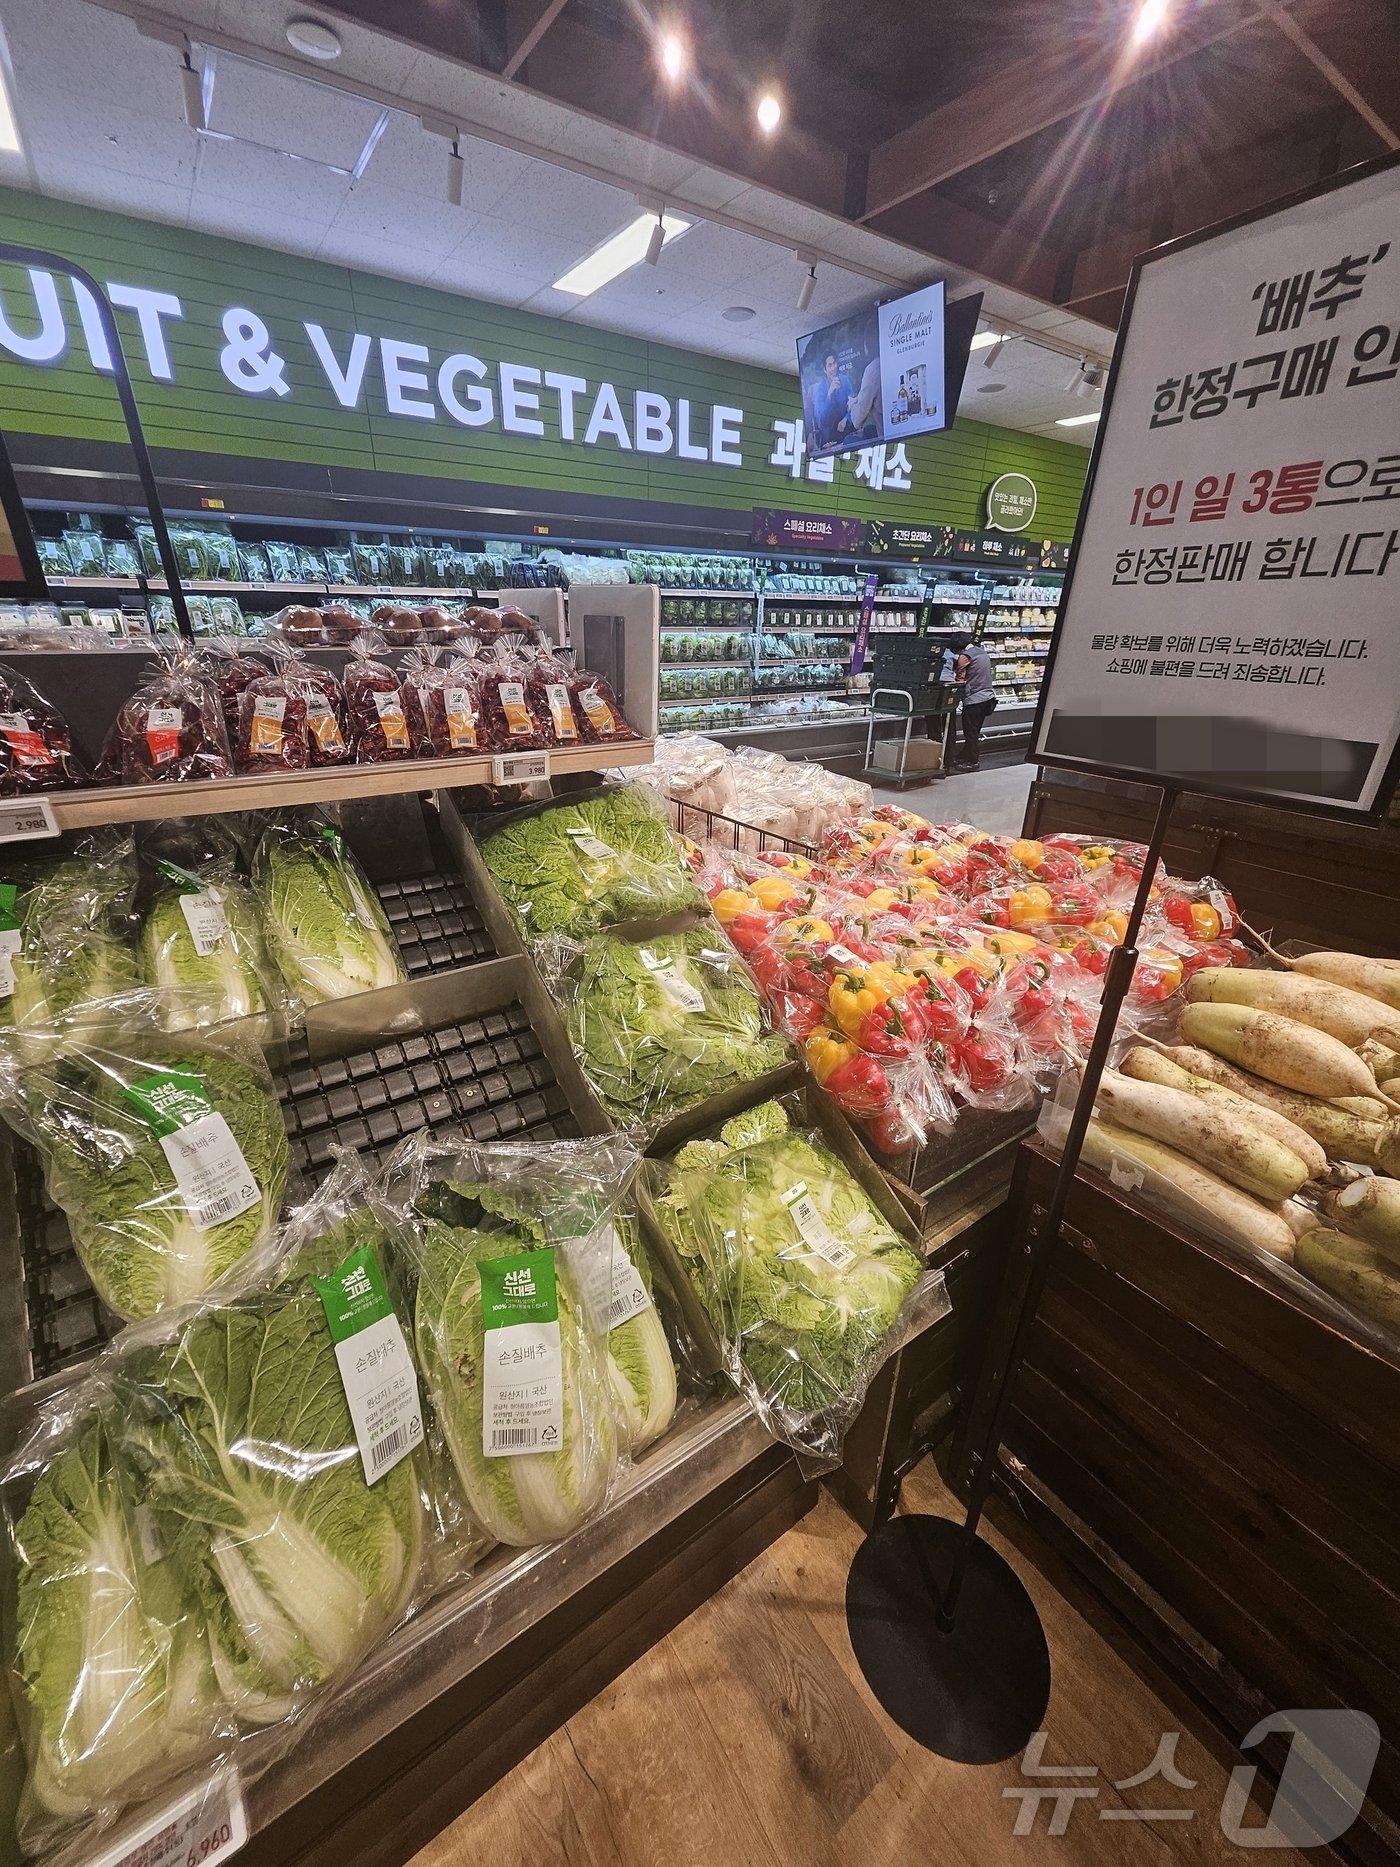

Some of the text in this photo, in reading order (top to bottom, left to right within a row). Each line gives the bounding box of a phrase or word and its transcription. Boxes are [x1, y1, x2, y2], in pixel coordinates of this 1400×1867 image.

[890, 326, 932, 347] SINGLE MALT
[220, 308, 291, 397] &
[303, 322, 743, 466] VEGETABLE
[1149, 335, 1340, 430] 한정구매
[1130, 480, 1183, 527] 1인
[1190, 472, 1236, 523] 일
[783, 519, 833, 535] 스페셜 요리채소
[892, 529, 933, 542] 초간단 요리채소
[1112, 530, 1400, 585] 한정판매 합니다
[1091, 634, 1369, 660] 물량 확보를 위해 더욱 노력하겠습니다.
[1106, 658, 1326, 687] 쇼핑에 불편을 드려 죄송합니다.
[180, 1132, 218, 1158] 손질배추
[192, 1170, 212, 1183] 원산지
[216, 1158, 232, 1170] 국산
[504, 1268, 532, 1286] 신선
[344, 1278, 372, 1302] 그대로
[502, 1282, 536, 1297] 그대로
[339, 1310, 354, 1322] 100%
[492, 1304, 508, 1312] 100%
[356, 1338, 396, 1374] 손질배추
[498, 1342, 548, 1366] 손질배추
[366, 1388, 388, 1410] 원산지
[392, 1376, 406, 1390] 국산
[500, 1384, 547, 1400] 원산지 국산
